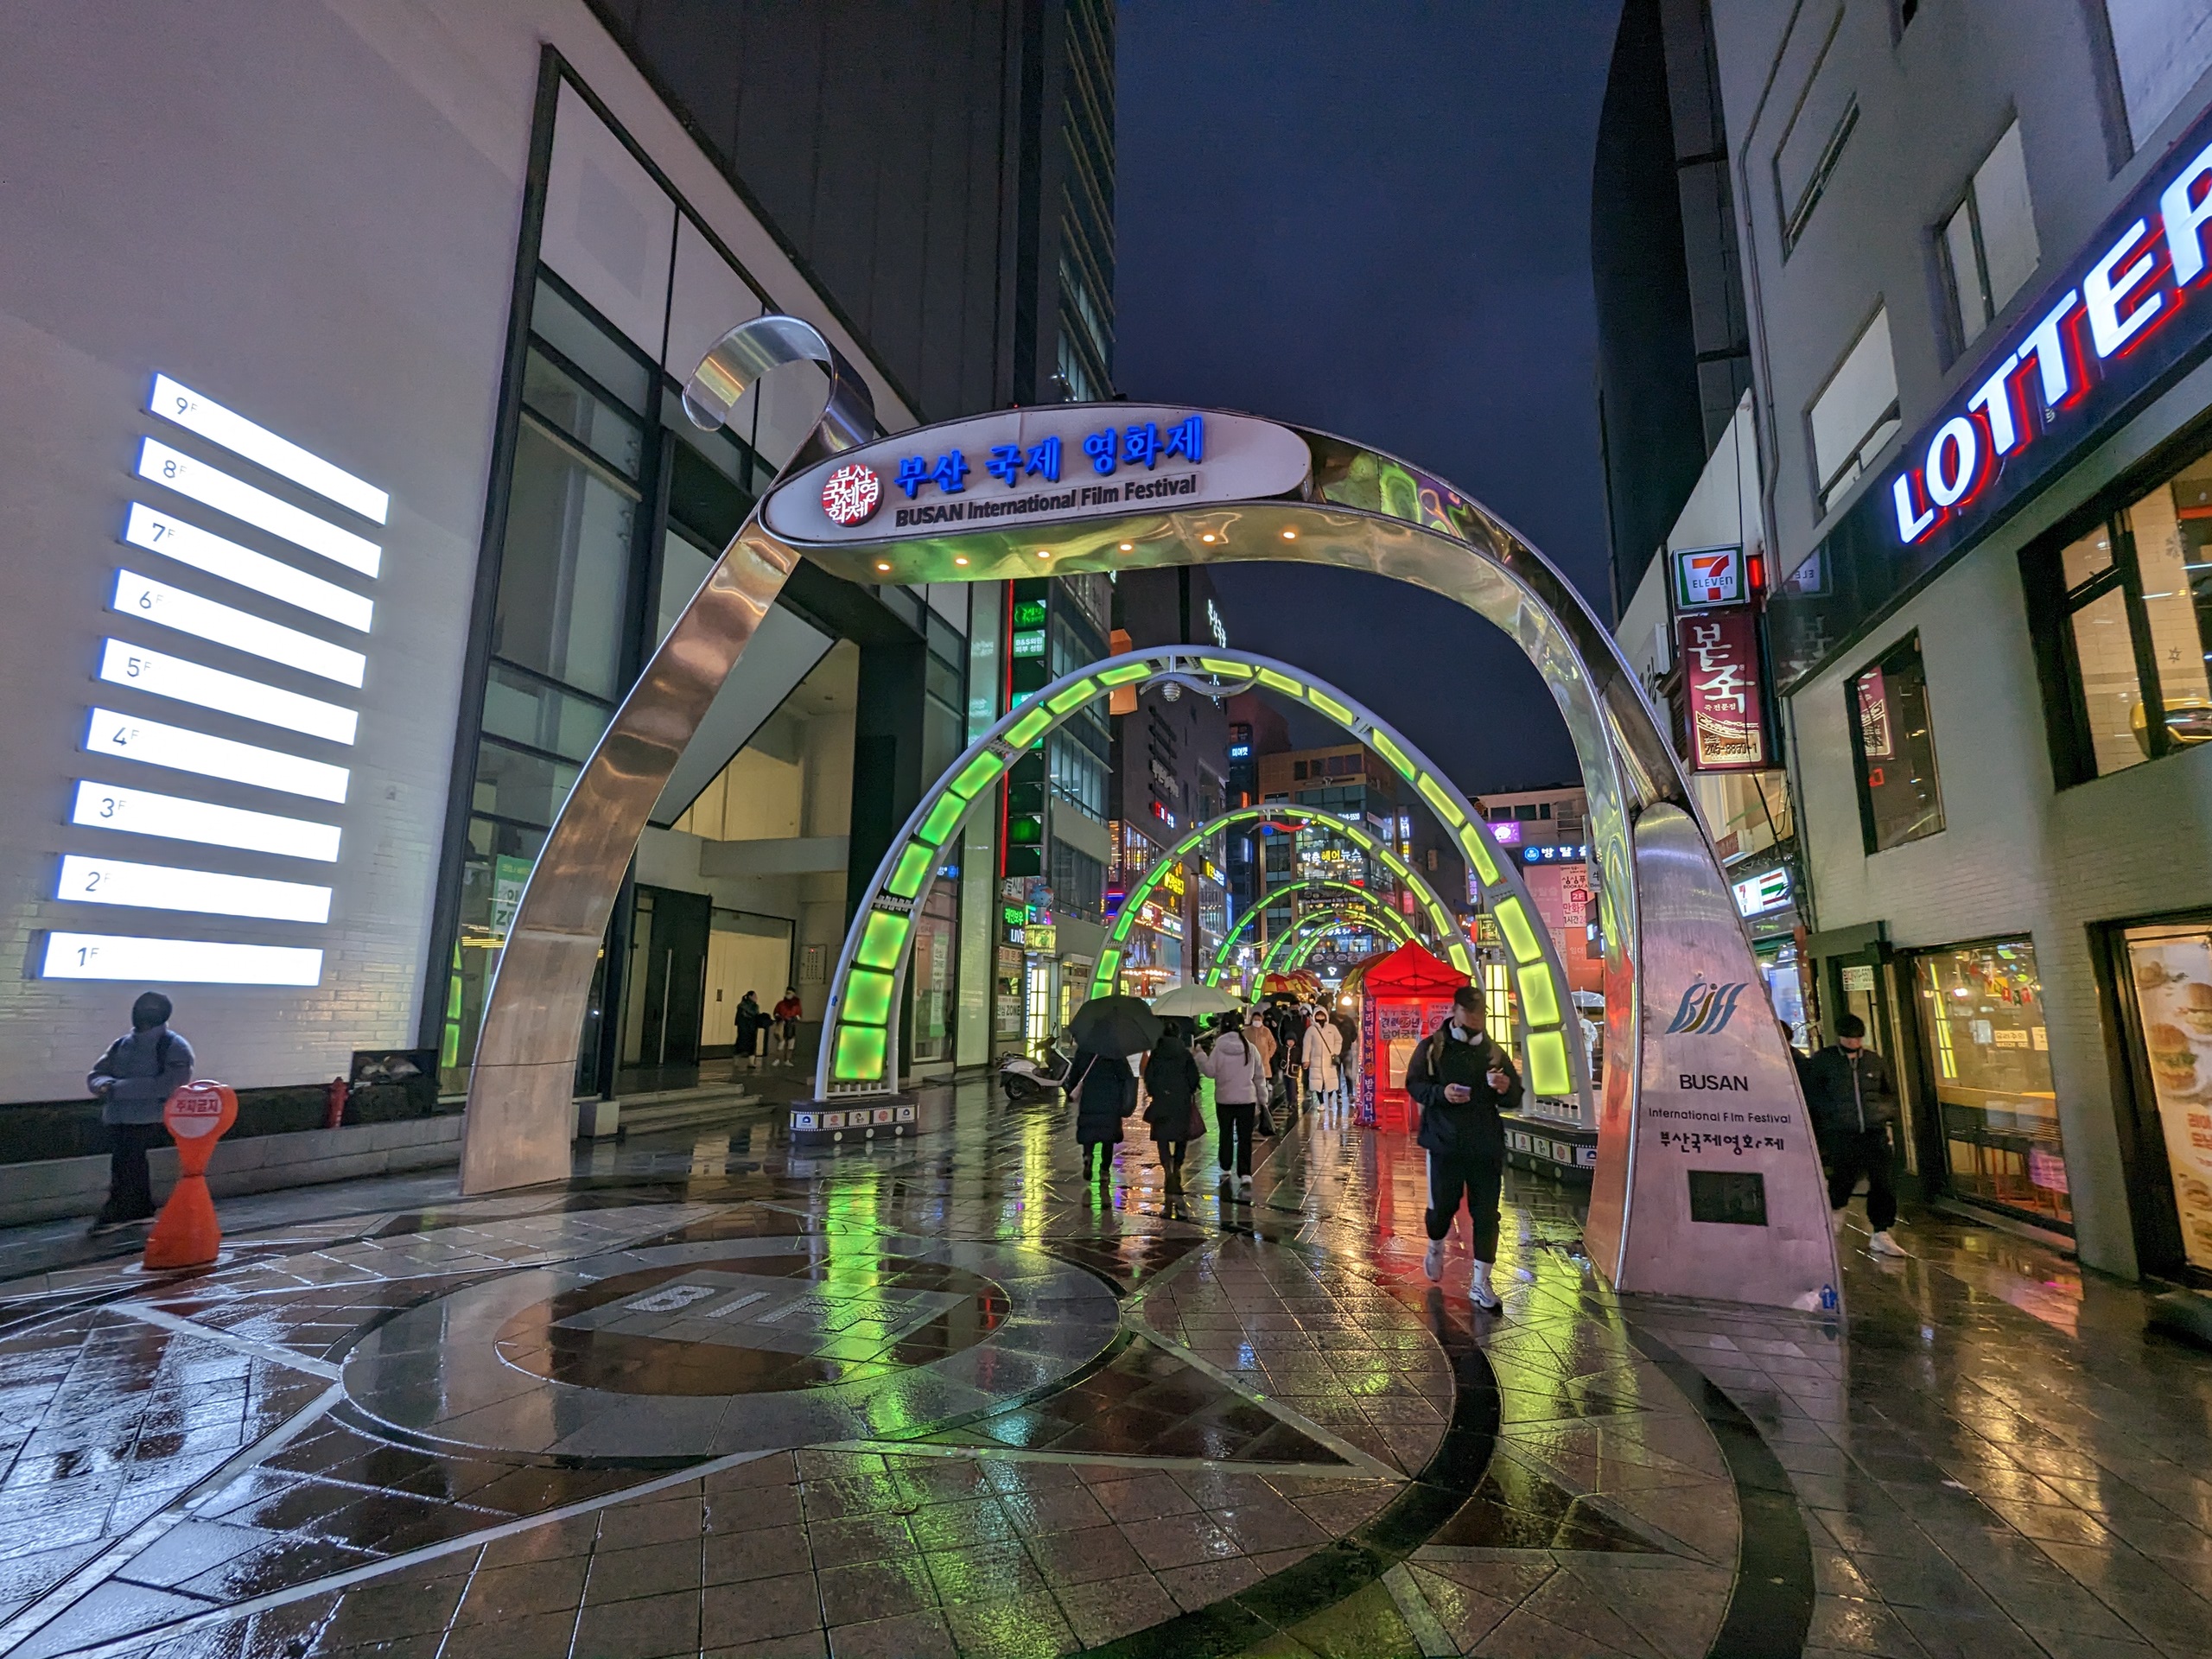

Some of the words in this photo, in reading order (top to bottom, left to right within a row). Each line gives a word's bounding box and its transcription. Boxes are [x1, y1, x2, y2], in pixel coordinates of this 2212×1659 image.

[175, 397, 198, 416] 9F
[893, 448, 969, 499] 부산
[985, 435, 1061, 486] 국제
[1084, 415, 1204, 474] 영화제
[163, 459, 187, 479] 8F
[895, 503, 963, 527] BUSAN
[968, 489, 1077, 519] International
[1081, 486, 1118, 506] Film
[1125, 474, 1196, 501] Festival
[151, 523, 175, 543] 7F
[139, 591, 164, 609] 6F
[127, 658, 152, 677] 5F
[1688, 624, 1756, 714] 본죽
[112, 728, 139, 747] 4F
[99, 798, 127, 818] 3F
[86, 872, 111, 893] 2F
[1010, 928, 1025, 944] LIVE
[76, 946, 99, 968] 1F
[1680, 1074, 1748, 1091] BUSAN
[1649, 1108, 1720, 1122] International
[1748, 1112, 1791, 1124] Festival
